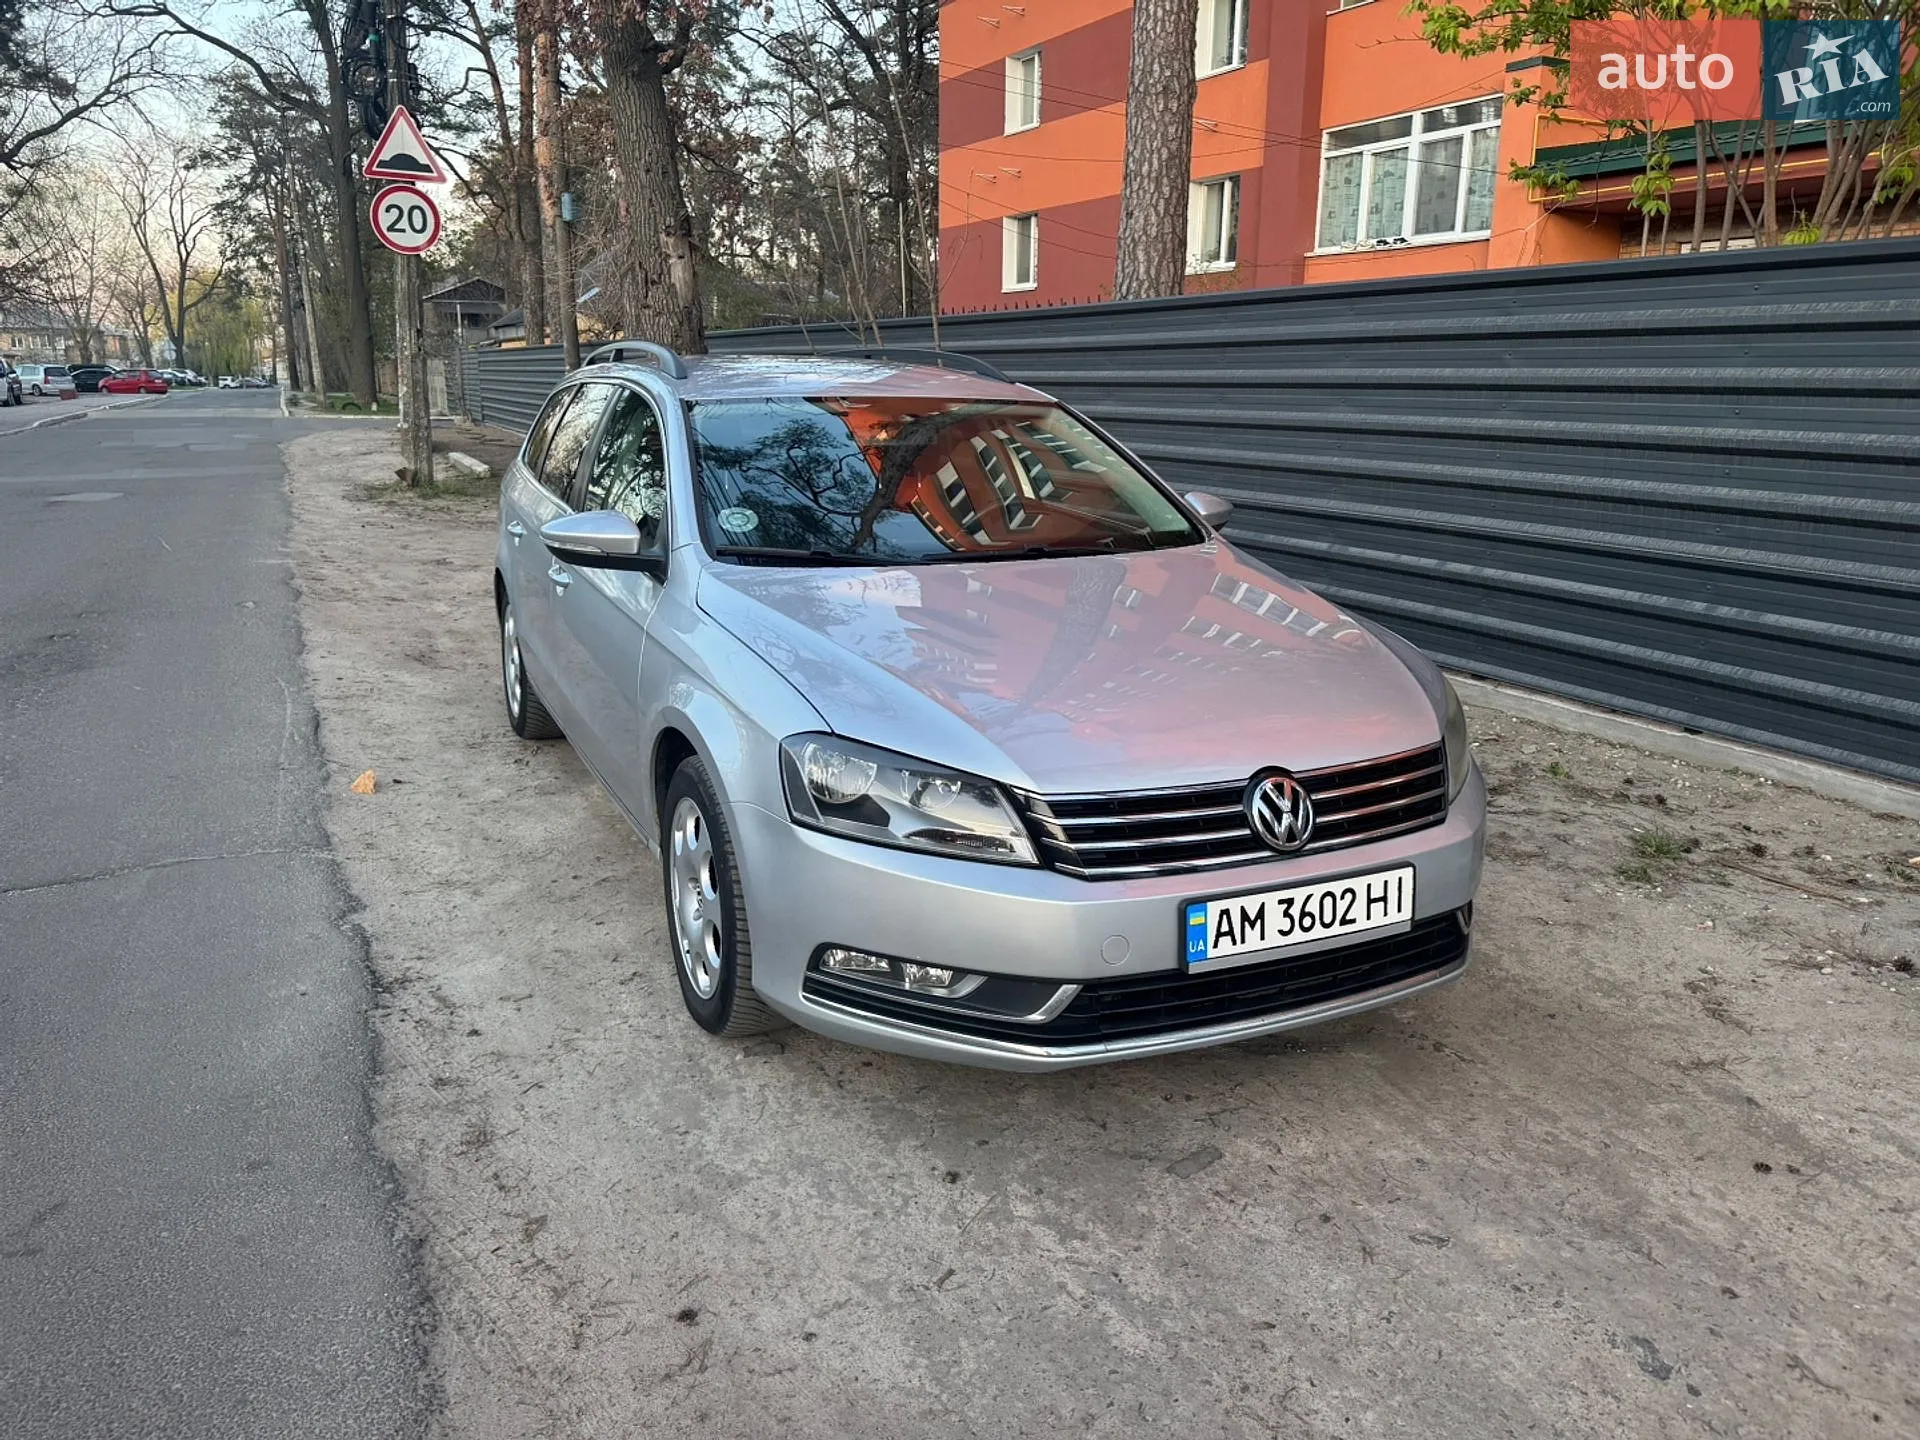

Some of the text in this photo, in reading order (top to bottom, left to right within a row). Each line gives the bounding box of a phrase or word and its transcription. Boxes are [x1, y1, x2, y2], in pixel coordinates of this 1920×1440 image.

[384, 203, 428, 235] 20
[1212, 876, 1402, 949] AM 3602 HI
[1189, 939, 1206, 953] UA
